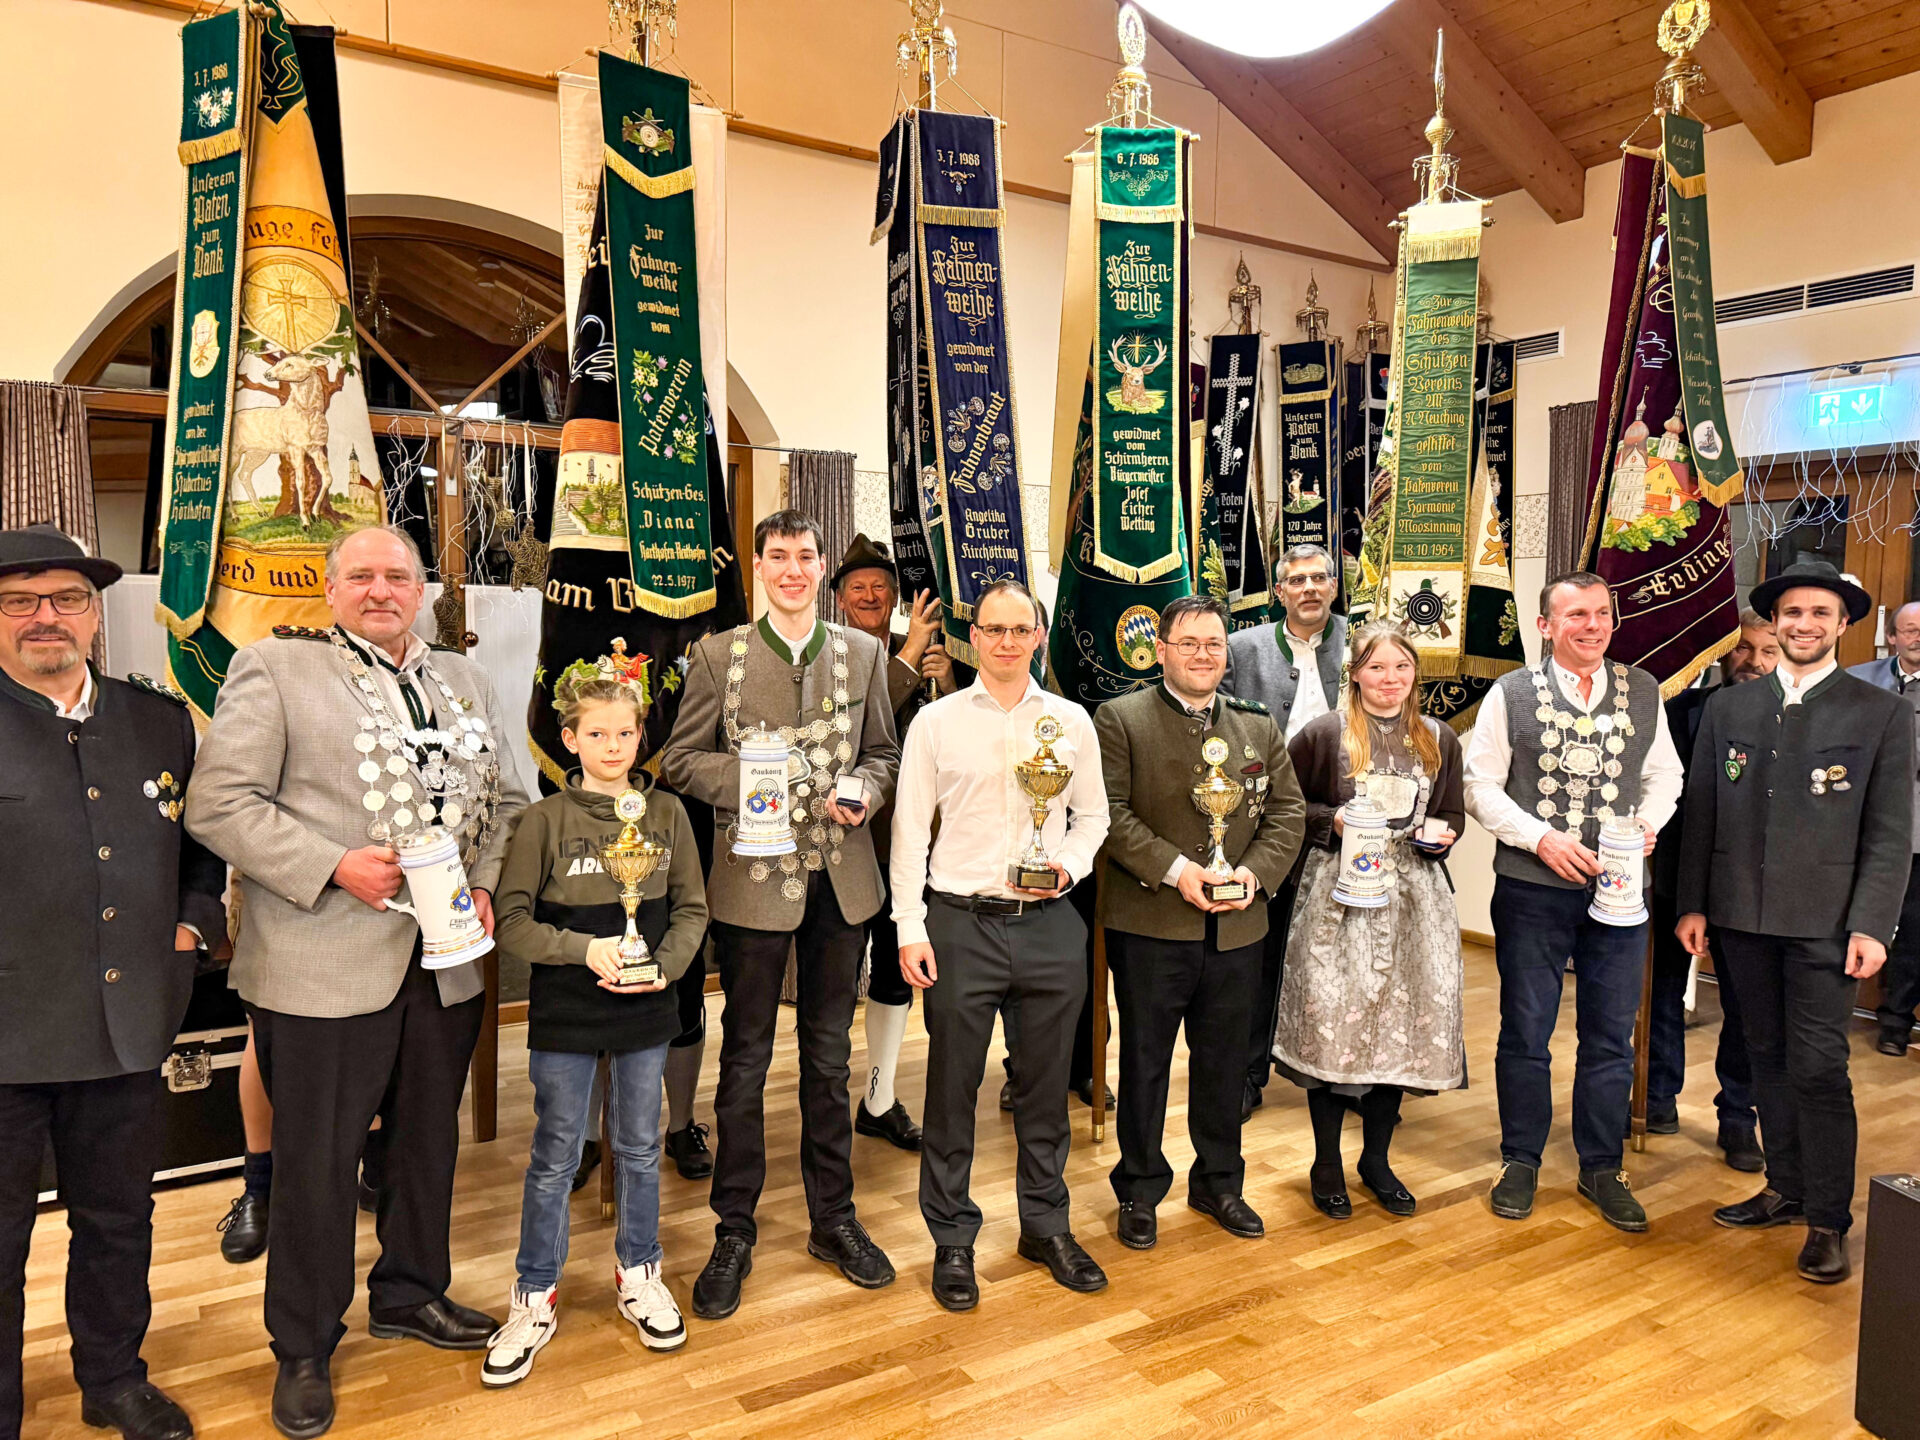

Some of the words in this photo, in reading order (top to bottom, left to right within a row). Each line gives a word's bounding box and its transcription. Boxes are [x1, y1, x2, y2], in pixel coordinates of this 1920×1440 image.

[193, 190, 231, 231] Paten
[201, 229, 219, 246] zum
[644, 223, 664, 241] Zur
[950, 235, 975, 254] Zur
[1124, 240, 1150, 257] Zur
[193, 240, 224, 280] Dank
[630, 243, 683, 279] Fahnen-
[932, 249, 998, 287] Fahnen-
[1106, 255, 1172, 289] Fahnen-
[641, 273, 678, 293] weihe
[637, 300, 680, 318] gewidmet
[1431, 295, 1452, 311] Zur
[650, 321, 671, 334] vom
[1407, 308, 1475, 334] Fahnenweihe
[1431, 329, 1449, 345] des
[947, 342, 996, 358] gewidmet
[954, 362, 973, 373] von
[974, 361, 989, 375] der
[1408, 375, 1463, 394] Vereins
[638, 358, 693, 456] Patenverein
[1285, 412, 1322, 423] Unserem
[1113, 427, 1161, 442] gewidmet
[1286, 421, 1320, 439] Paten
[949, 391, 1006, 494] Fahnenbraut
[1126, 442, 1146, 451] vom
[1289, 441, 1320, 460] Dank
[1296, 437, 1313, 446] zum
[1104, 451, 1170, 467] Schirmherrn
[1421, 462, 1442, 472] vom
[1110, 466, 1165, 485] Bürgermeister
[1125, 486, 1149, 503] Josef
[1402, 476, 1459, 498] Patenverein
[965, 508, 1006, 526] Angelika
[1121, 501, 1155, 517] Eicher
[965, 523, 1010, 540] Gruber
[1120, 515, 1155, 533] Wetting
[1303, 520, 1322, 533] Jahre
[1399, 519, 1462, 537] Moosinning
[961, 542, 1018, 563] Kirchötting
[1402, 543, 1455, 556] 18.10.1964
[268, 563, 323, 588] und
[1637, 540, 1730, 597] Erding
[651, 574, 696, 591] 22.5.1977
[546, 578, 596, 612] am
[751, 768, 782, 776] Gaukönig
